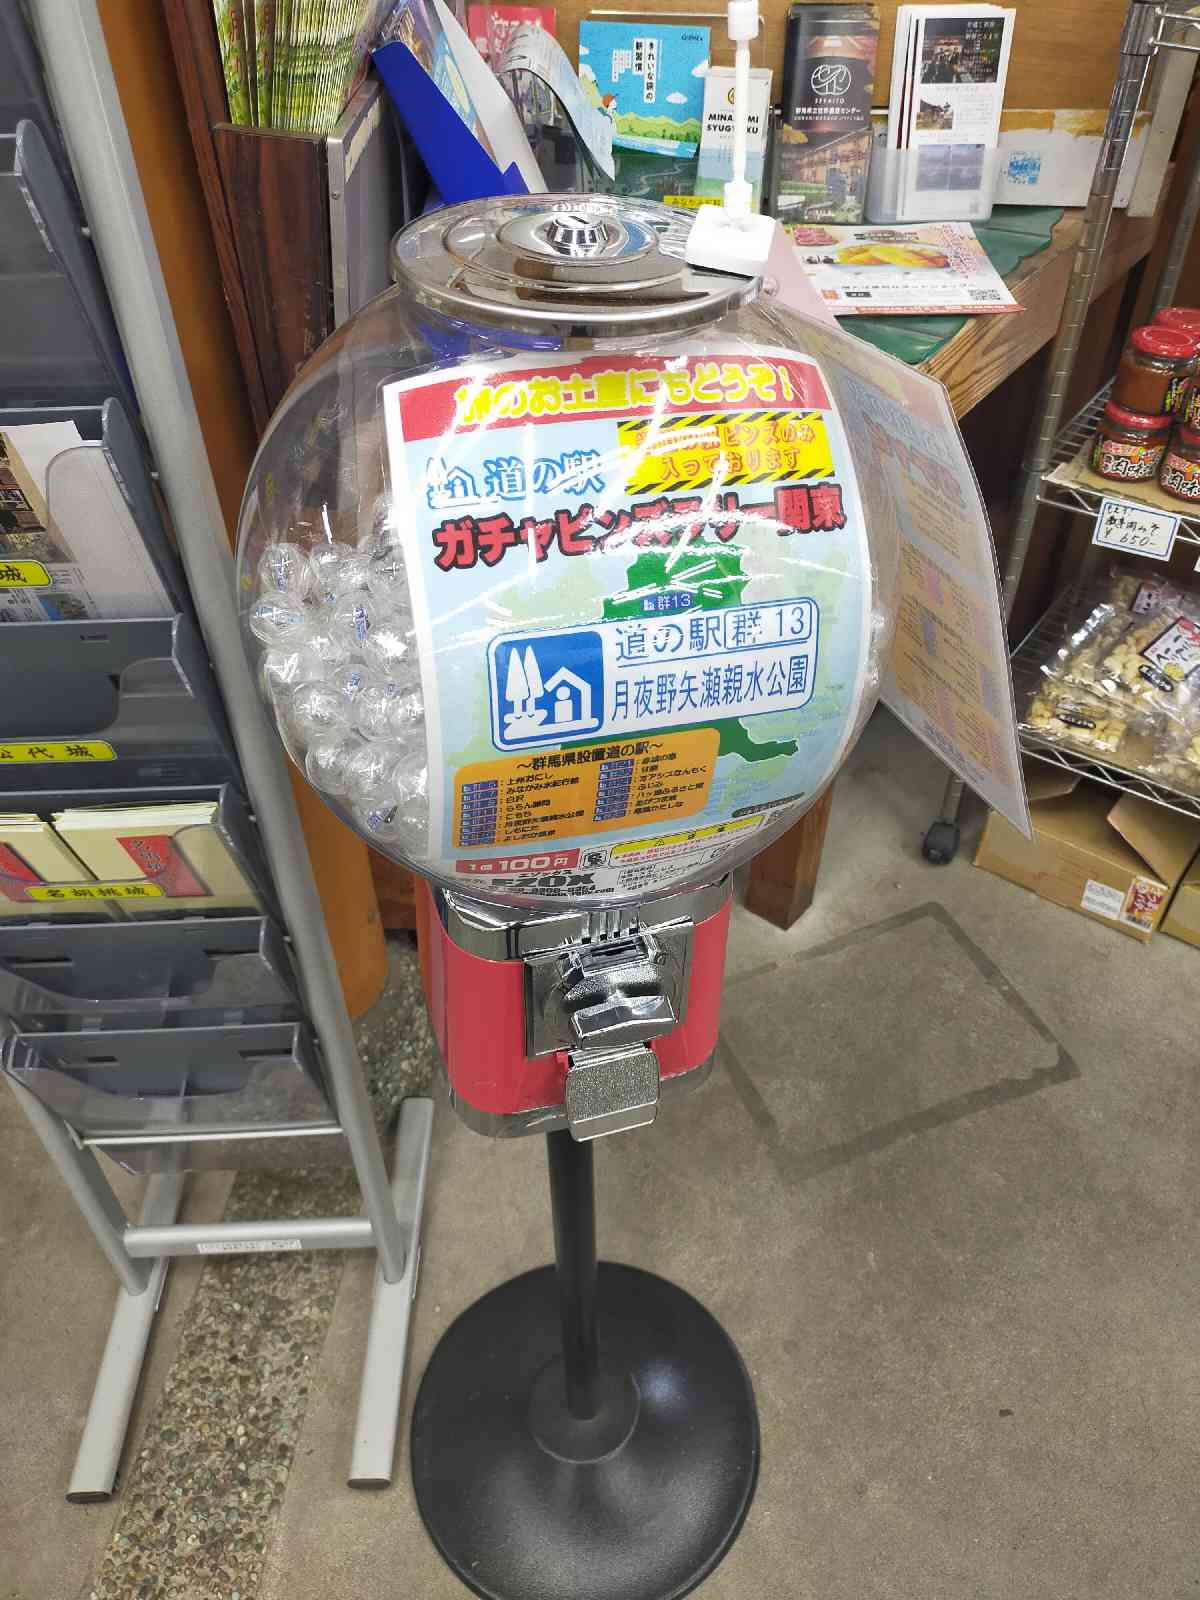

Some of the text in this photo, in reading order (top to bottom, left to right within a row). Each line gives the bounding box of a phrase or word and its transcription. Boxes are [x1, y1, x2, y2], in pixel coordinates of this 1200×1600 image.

[615, 615, 722, 662] 道の駅
[775, 606, 805, 637] 13
[611, 654, 809, 721] 月夜野矢瀬親水公園
